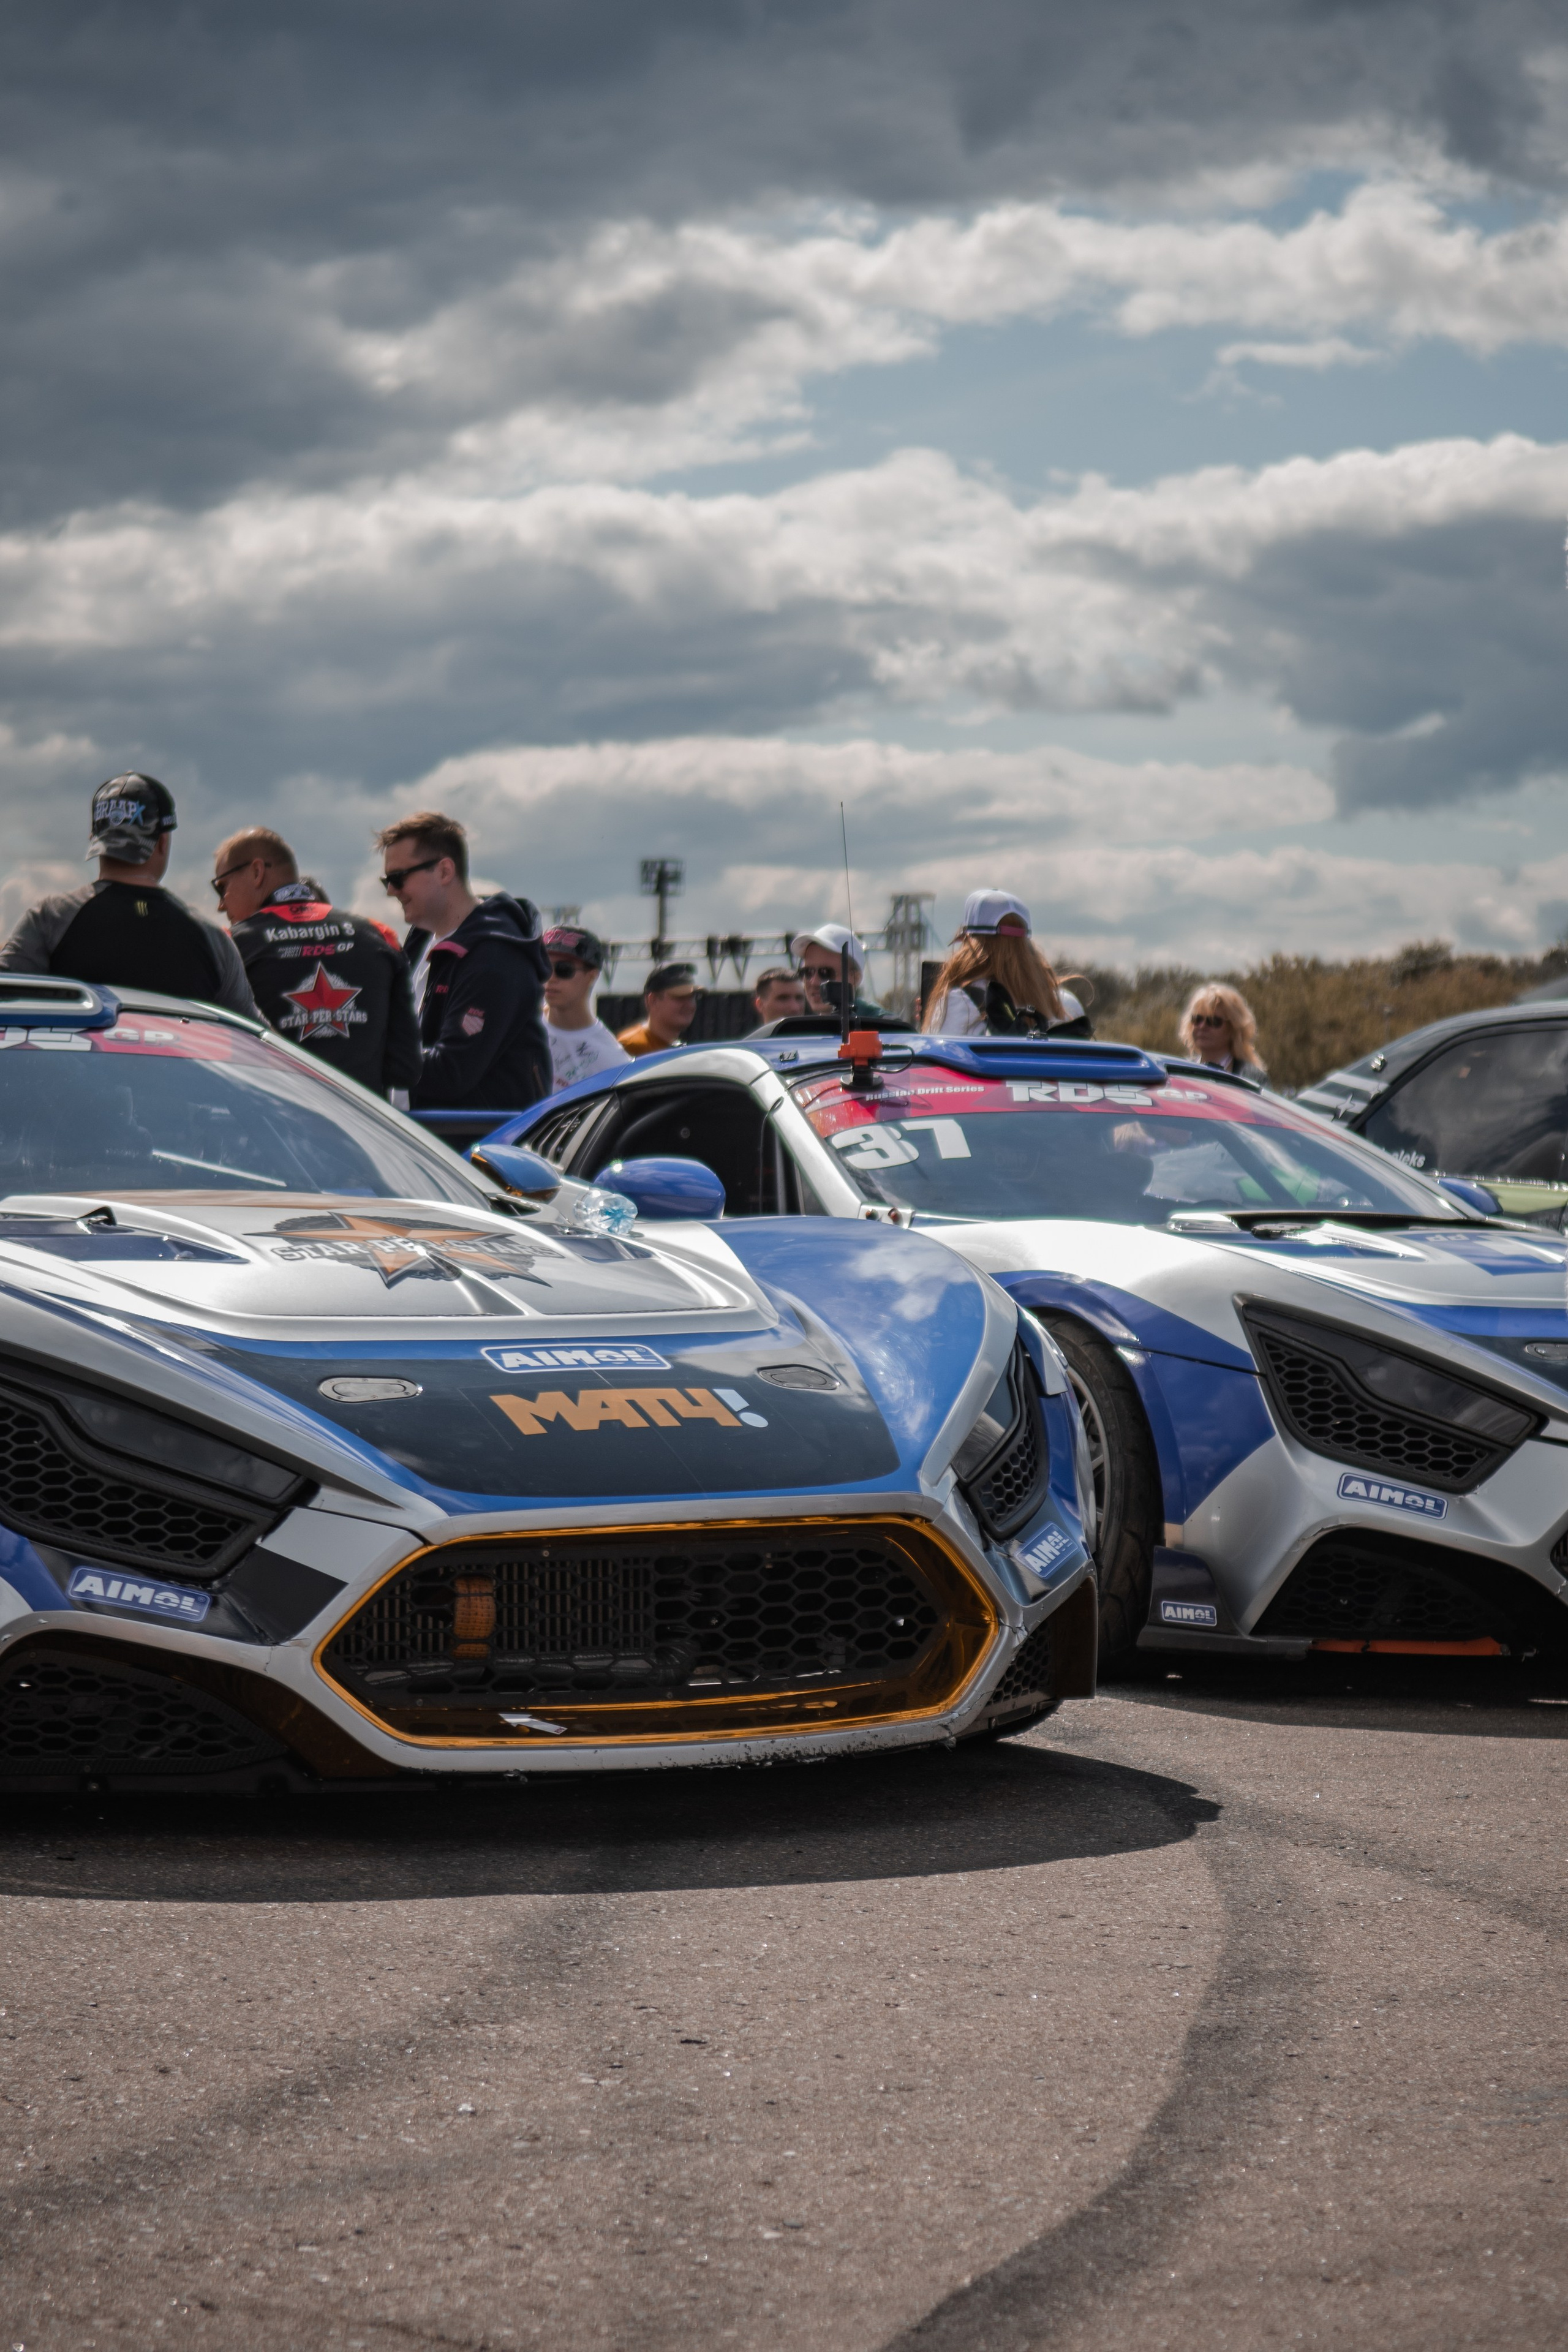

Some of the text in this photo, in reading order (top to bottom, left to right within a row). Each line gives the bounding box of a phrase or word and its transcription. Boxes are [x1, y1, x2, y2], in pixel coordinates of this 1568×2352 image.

[265, 924, 340, 943] Kabargin
[302, 944, 336, 957] RDS
[337, 942, 355, 952] GP
[280, 1013, 309, 1029] STAR
[336, 1010, 368, 1023] STARS
[103, 1027, 175, 1046] GP
[865, 1090, 916, 1101] Russian
[918, 1087, 944, 1095] Drift
[1006, 1080, 1210, 1107] RDS GP
[272, 1240, 368, 1261] STAR
[444, 1240, 565, 1259] STARS
[501, 1349, 657, 1368] AIMOL
[1343, 1480, 1441, 1515] AIMOL
[1024, 1530, 1073, 1573] AIMOL
[74, 1575, 200, 1616] AIMOL
[1164, 1606, 1214, 1622] AIMOL
